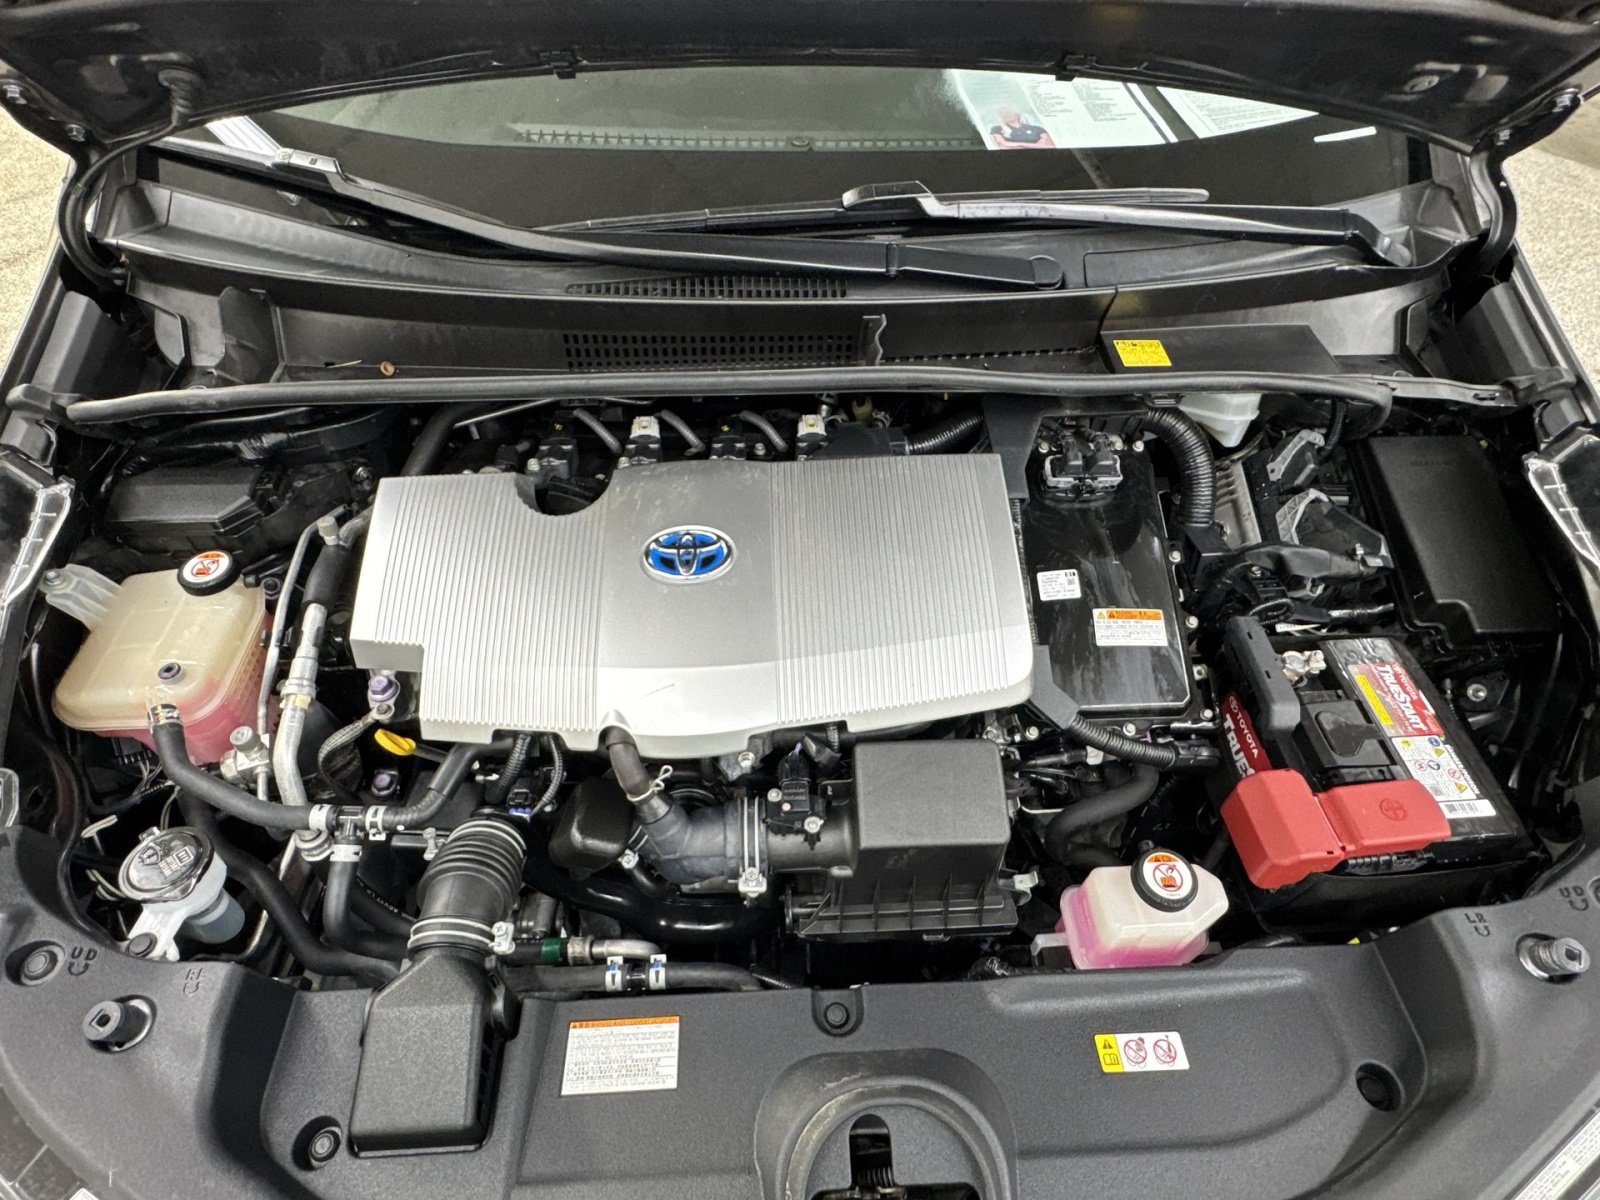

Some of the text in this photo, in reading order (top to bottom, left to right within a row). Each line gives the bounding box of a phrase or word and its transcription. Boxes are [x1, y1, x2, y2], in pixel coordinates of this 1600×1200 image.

[1376, 665, 1427, 731] TRUESTART
[1399, 668, 1419, 701] TOYOTA
[1236, 713, 1259, 759] TOYOTA
